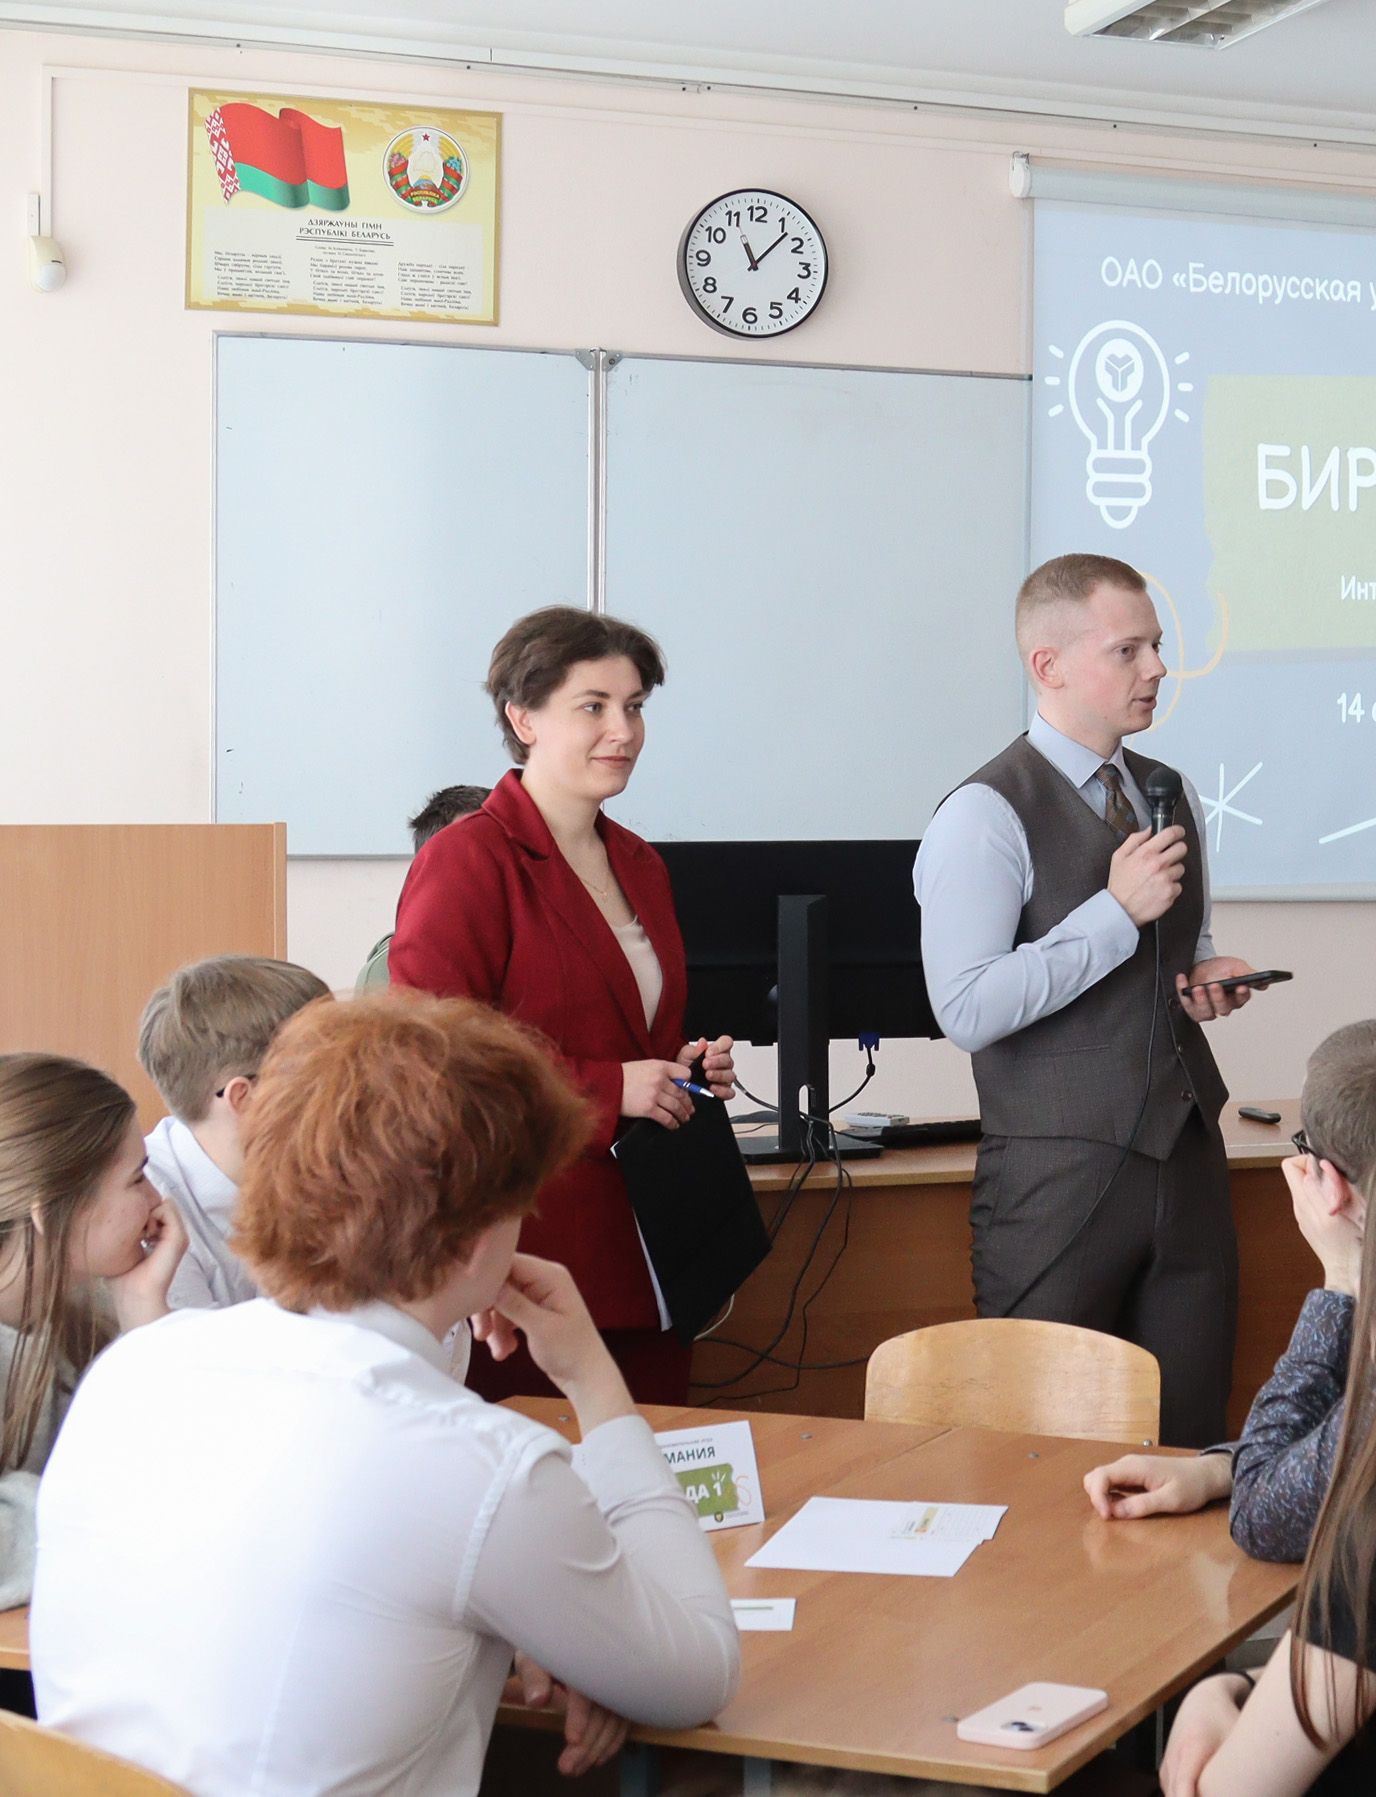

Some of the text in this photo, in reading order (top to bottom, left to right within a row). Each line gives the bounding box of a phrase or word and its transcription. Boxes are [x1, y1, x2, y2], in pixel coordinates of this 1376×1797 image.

[725, 210, 741, 227] 11
[747, 205, 768, 223] 12
[778, 217, 786, 233] 1
[351, 231, 391, 239] БЕЛАРУСЬ
[705, 226, 726, 244] 10
[791, 237, 804, 254] 2
[695, 249, 711, 267] 9
[797, 262, 811, 279] 3
[702, 276, 717, 294] 8
[1102, 257, 1162, 289] ОАО
[1173, 263, 1360, 304] «Белорусская
[786, 287, 801, 304] 4
[721, 295, 734, 314] 7
[769, 301, 783, 319] 5
[742, 307, 758, 324] 6
[1337, 693, 1365, 723] 14
[713, 1481, 722, 1496] 1
